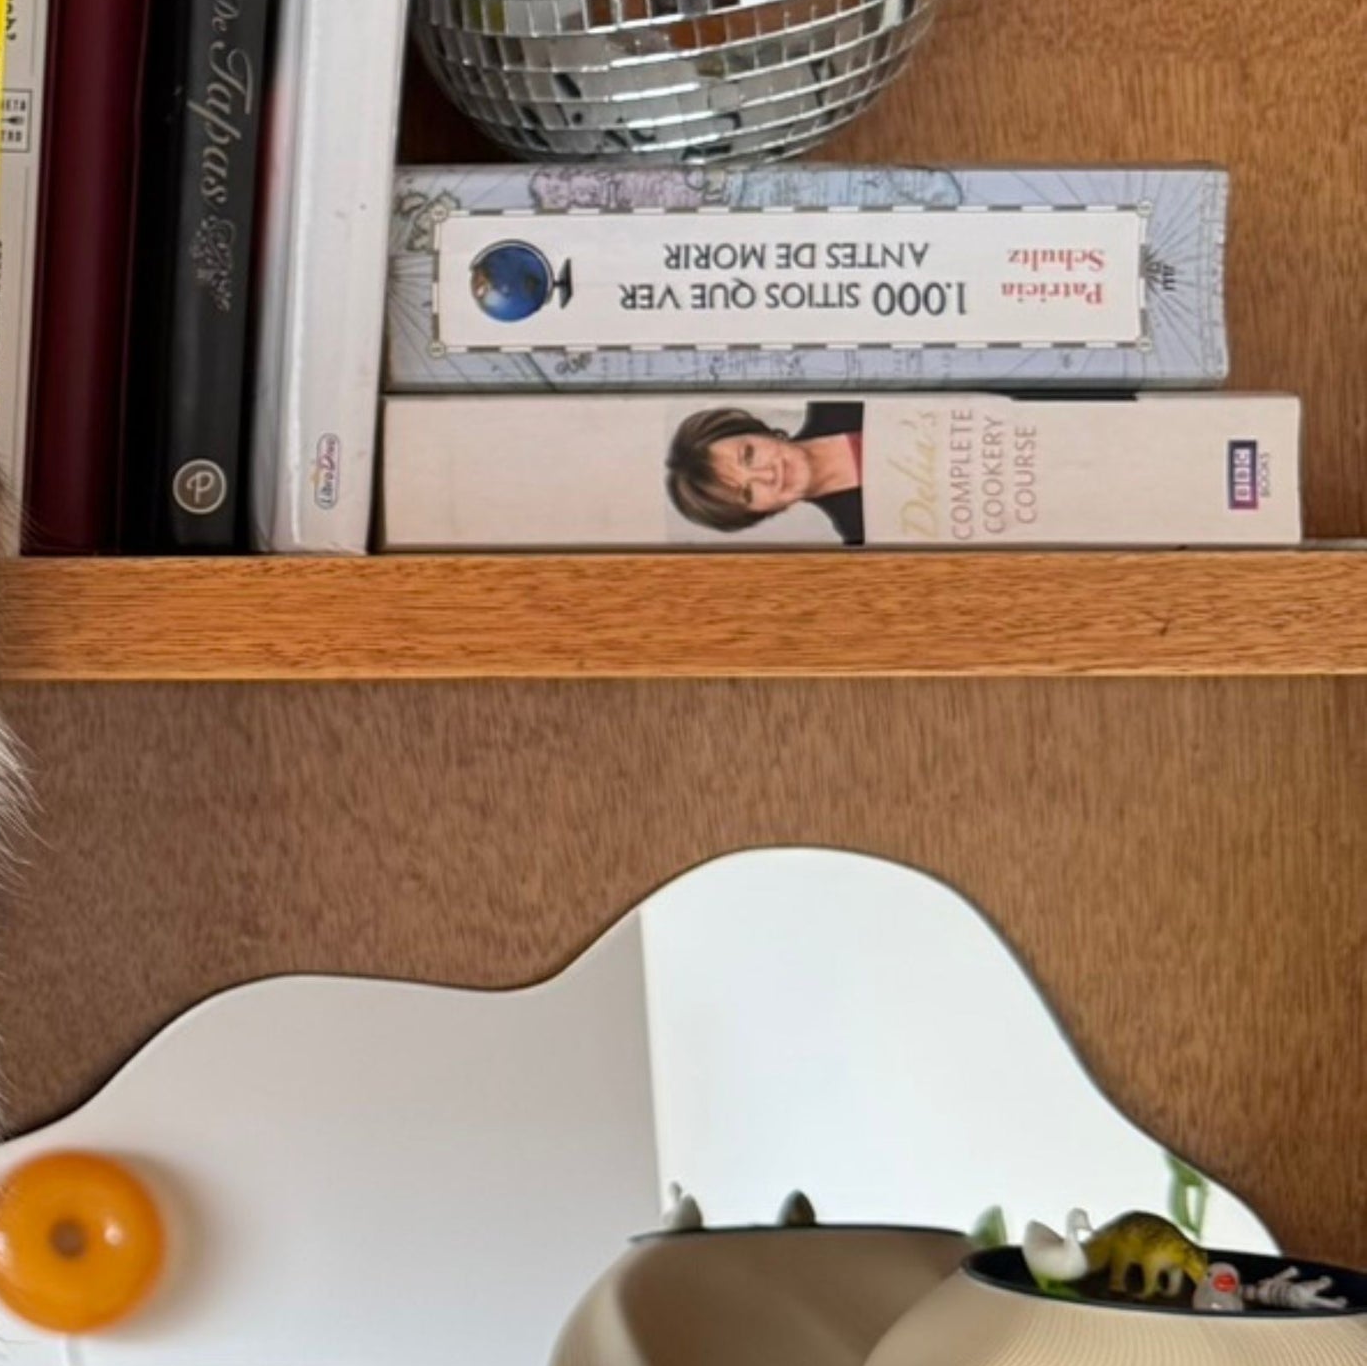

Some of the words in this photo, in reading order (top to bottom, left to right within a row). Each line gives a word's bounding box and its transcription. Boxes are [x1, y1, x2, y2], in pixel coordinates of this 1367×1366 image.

[187, 41, 253, 206] Tapas
[663, 242, 766, 270] MORIR
[775, 242, 817, 269] DE
[825, 242, 930, 269] ANTES
[1007, 247, 1106, 271] Schultz
[618, 282, 682, 310] VER
[690, 278, 757, 310] QUE
[765, 281, 862, 310] SITIOS
[873, 281, 969, 317] 1.000
[1000, 282, 1104, 306] Patricia
[950, 408, 975, 542] COMPLETE
[982, 415, 1006, 535] COOKERY
[1014, 424, 1038, 526] COURSE
[1233, 447, 1252, 502] BBC
